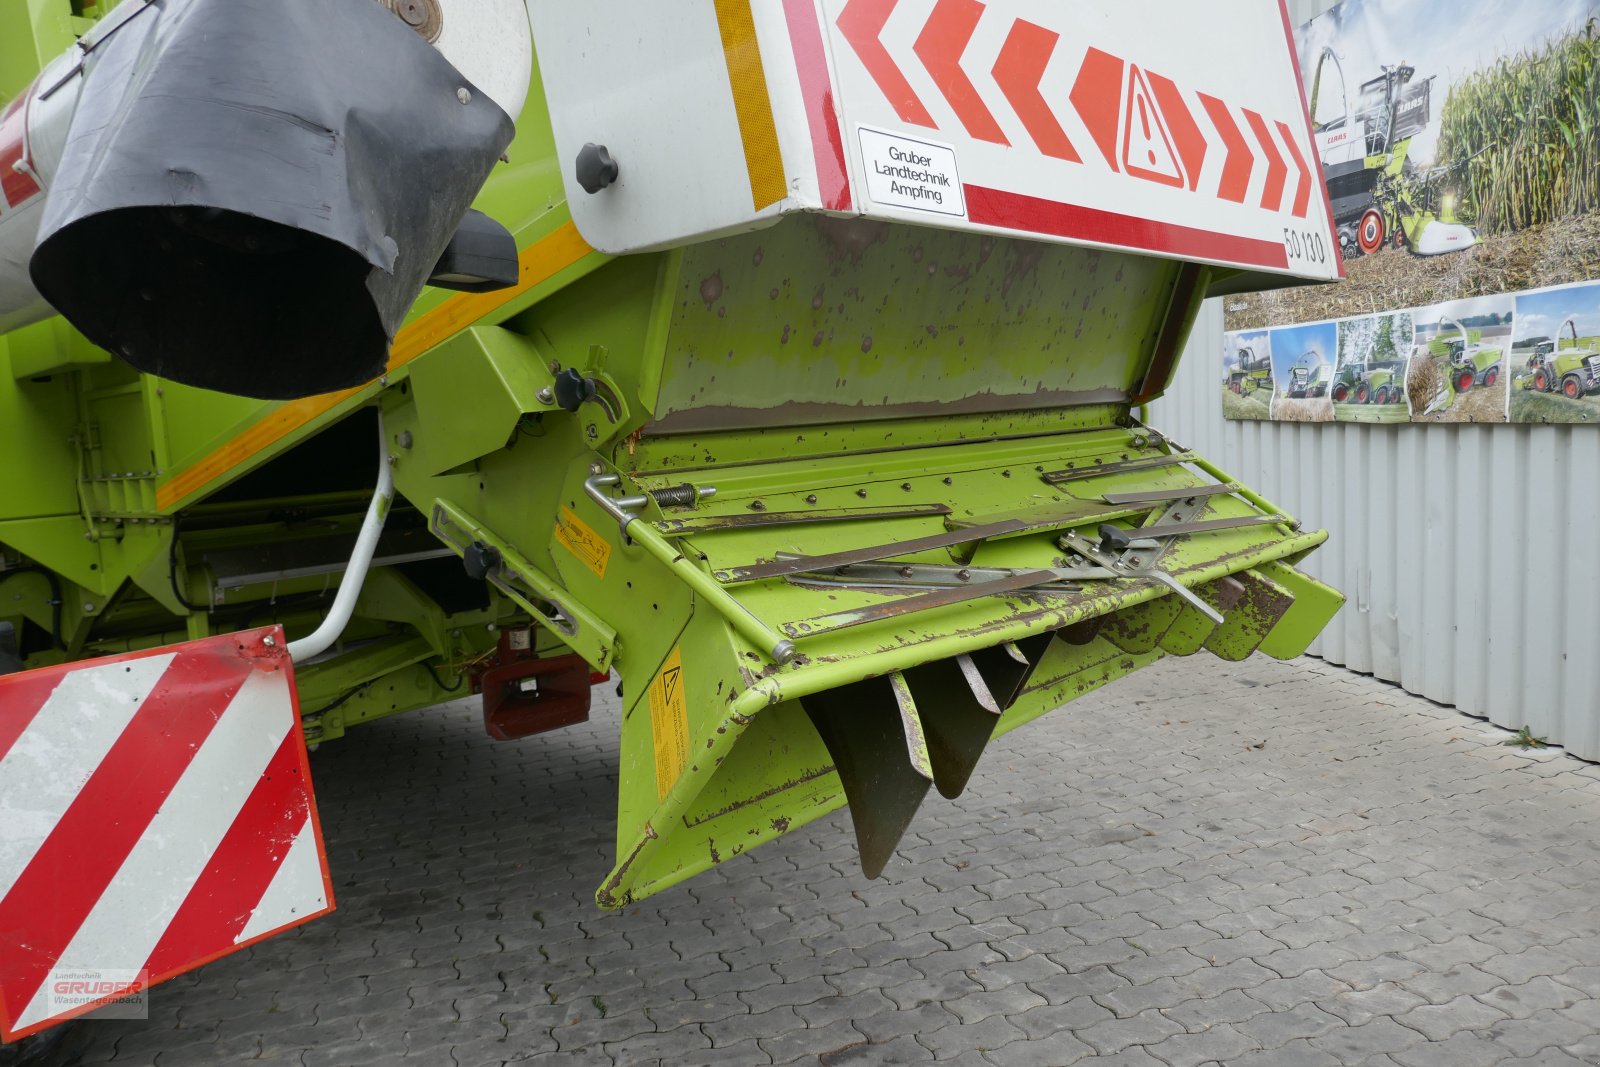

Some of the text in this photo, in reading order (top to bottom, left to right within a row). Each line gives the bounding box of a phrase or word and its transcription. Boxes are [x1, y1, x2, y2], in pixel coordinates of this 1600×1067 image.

[1327, 132, 1347, 144] CLAAS
[888, 146, 932, 167] Gruber
[874, 159, 951, 188] Landtechnik
[890, 180, 943, 205] Ampfing
